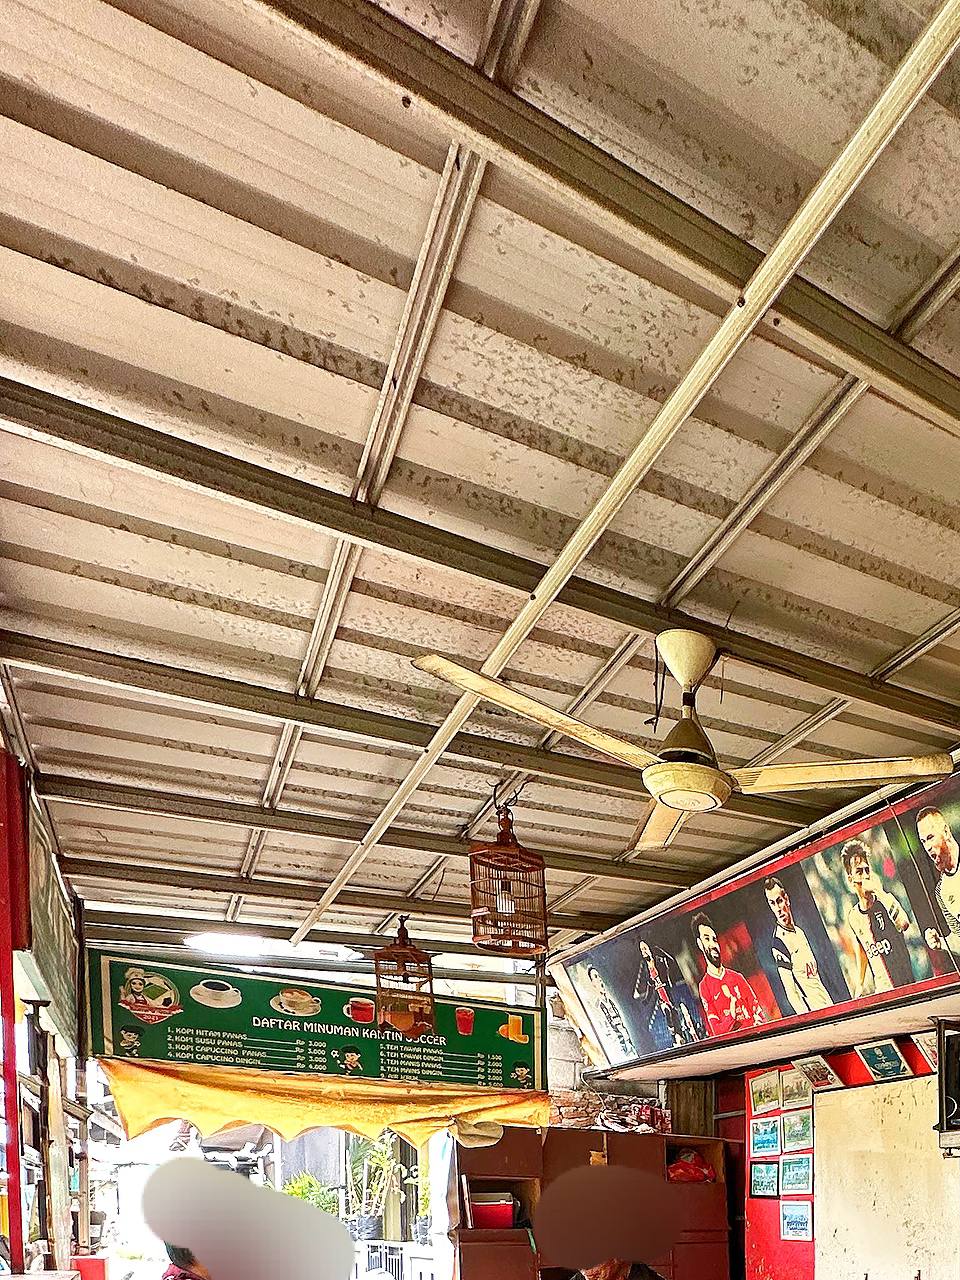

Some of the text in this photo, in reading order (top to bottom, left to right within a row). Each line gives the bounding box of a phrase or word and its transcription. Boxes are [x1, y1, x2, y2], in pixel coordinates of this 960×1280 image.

[175, 1028, 194, 1036] KOPI
[195, 1029, 221, 1038] HITAM
[222, 1032, 248, 1041] PANAS
[252, 1016, 300, 1030] DAFTAR
[303, 1022, 359, 1037] MINUMAN
[362, 1028, 403, 1042] KANTIN
[195, 1037, 216, 1045] SUSU
[217, 1039, 243, 1047] PANAS
[175, 1052, 194, 1060] KOPI
[195, 1045, 238, 1056] CAPUCCINO
